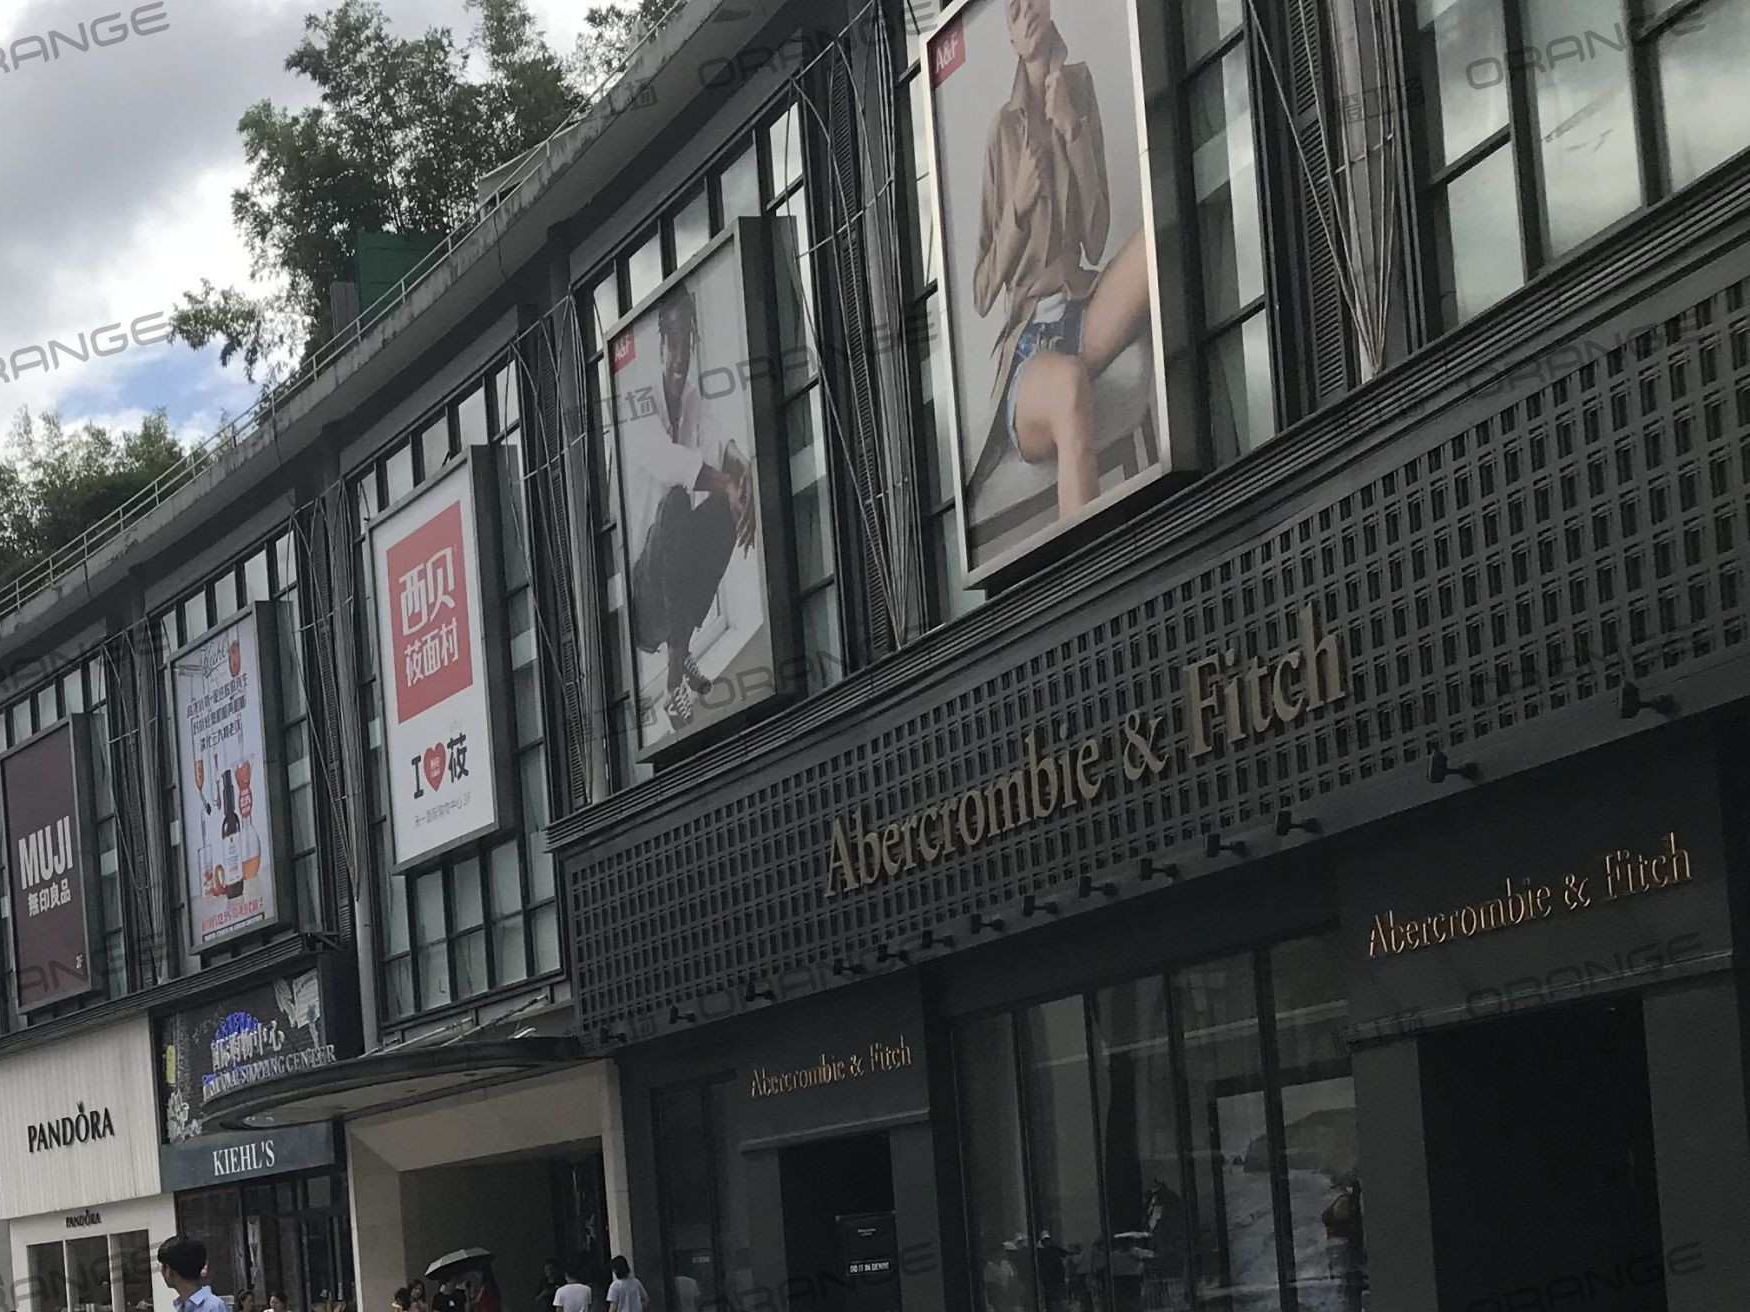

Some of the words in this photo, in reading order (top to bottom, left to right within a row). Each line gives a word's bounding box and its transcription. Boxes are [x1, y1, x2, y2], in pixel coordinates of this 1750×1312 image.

[933, 38, 961, 75] A&F
[614, 340, 633, 366] A&F
[398, 543, 456, 636] 西贝
[404, 622, 459, 688] 莜面村
[824, 727, 1101, 898] Abercrombie
[1123, 708, 1170, 781] &
[1184, 601, 1346, 758] Fitch
[411, 754, 424, 800] I
[18, 815, 74, 890] MUJI
[26, 880, 72, 917] 無印良品
[1368, 877, 1552, 959] Abercrombie
[1563, 873, 1592, 911] &
[1602, 831, 1693, 904] Fitch
[751, 1053, 846, 1098] Abercrombie
[850, 1054, 865, 1077] &
[869, 1034, 912, 1072] Fitch
[27, 1104, 115, 1153] PANDORA
[211, 1138, 276, 1177] KIEHL'S
[65, 1210, 102, 1228] PANDORA
